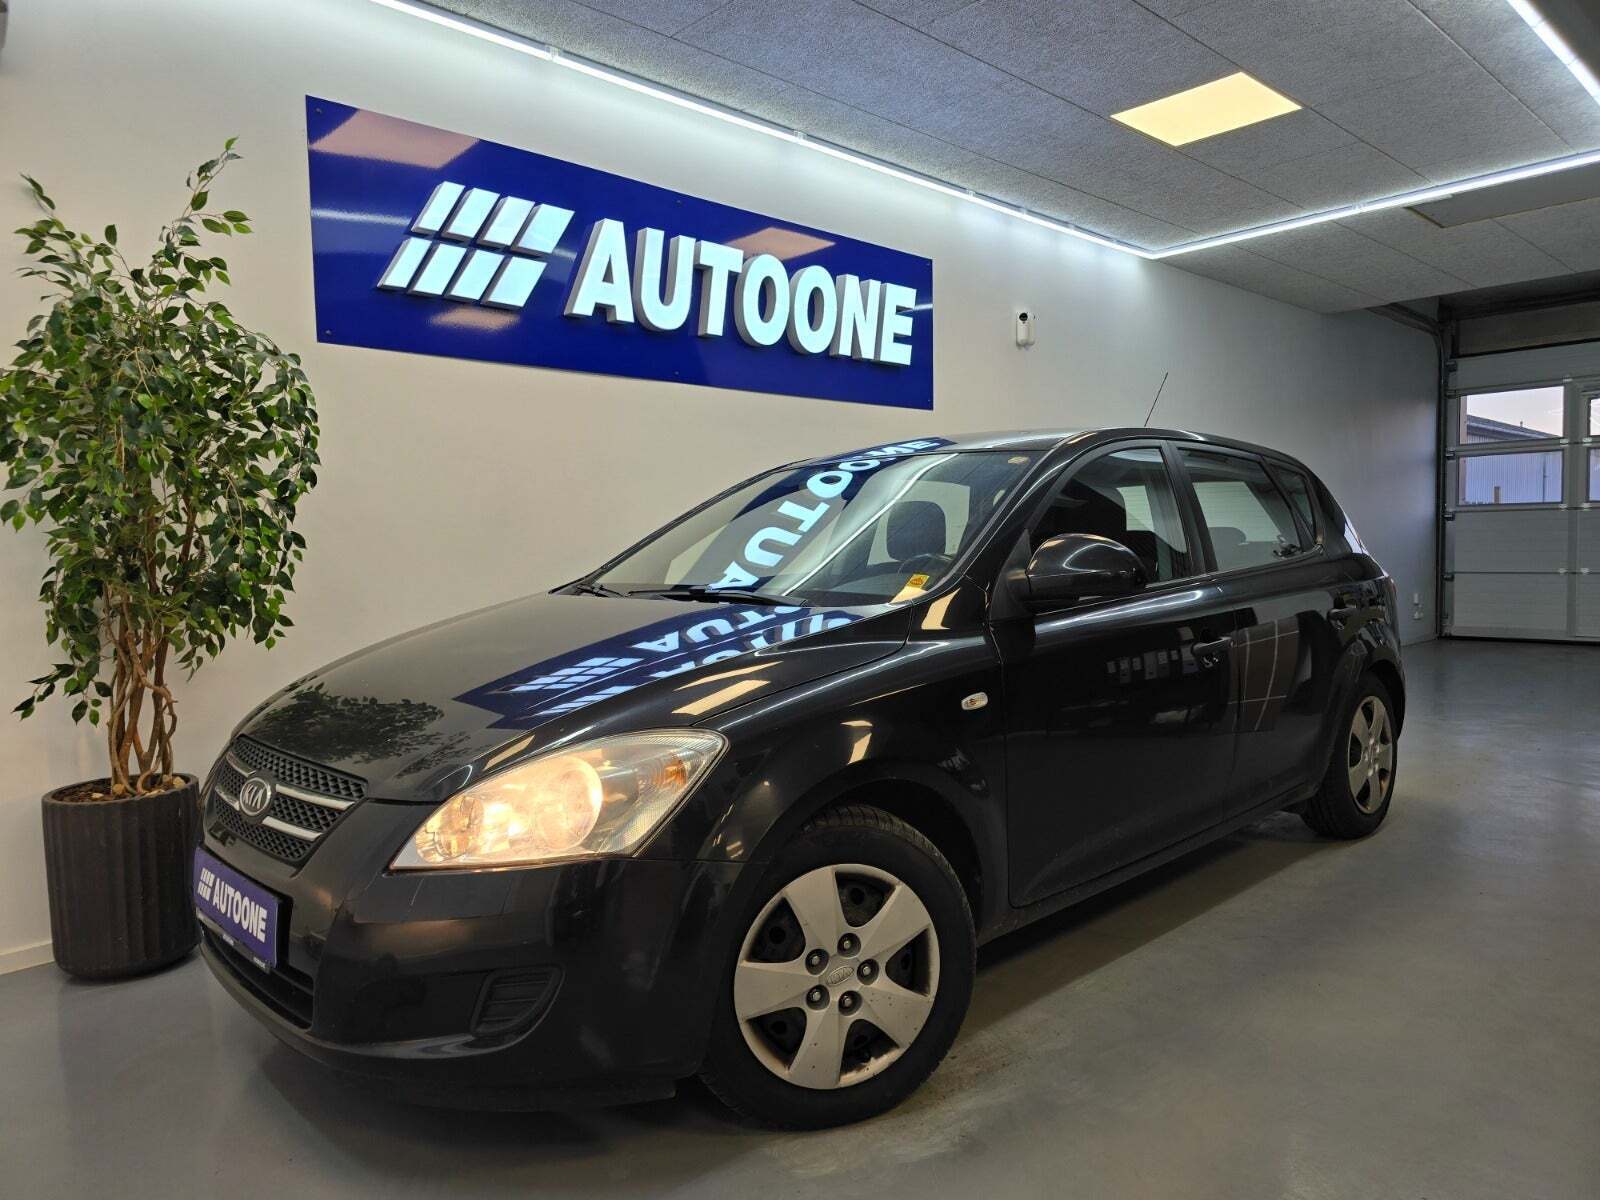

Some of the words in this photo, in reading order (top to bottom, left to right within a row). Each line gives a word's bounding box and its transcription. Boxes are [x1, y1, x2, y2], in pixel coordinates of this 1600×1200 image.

[565, 217, 917, 367] AUTOONE
[242, 783, 265, 811] KIA
[213, 878, 268, 943] AUTOONE
